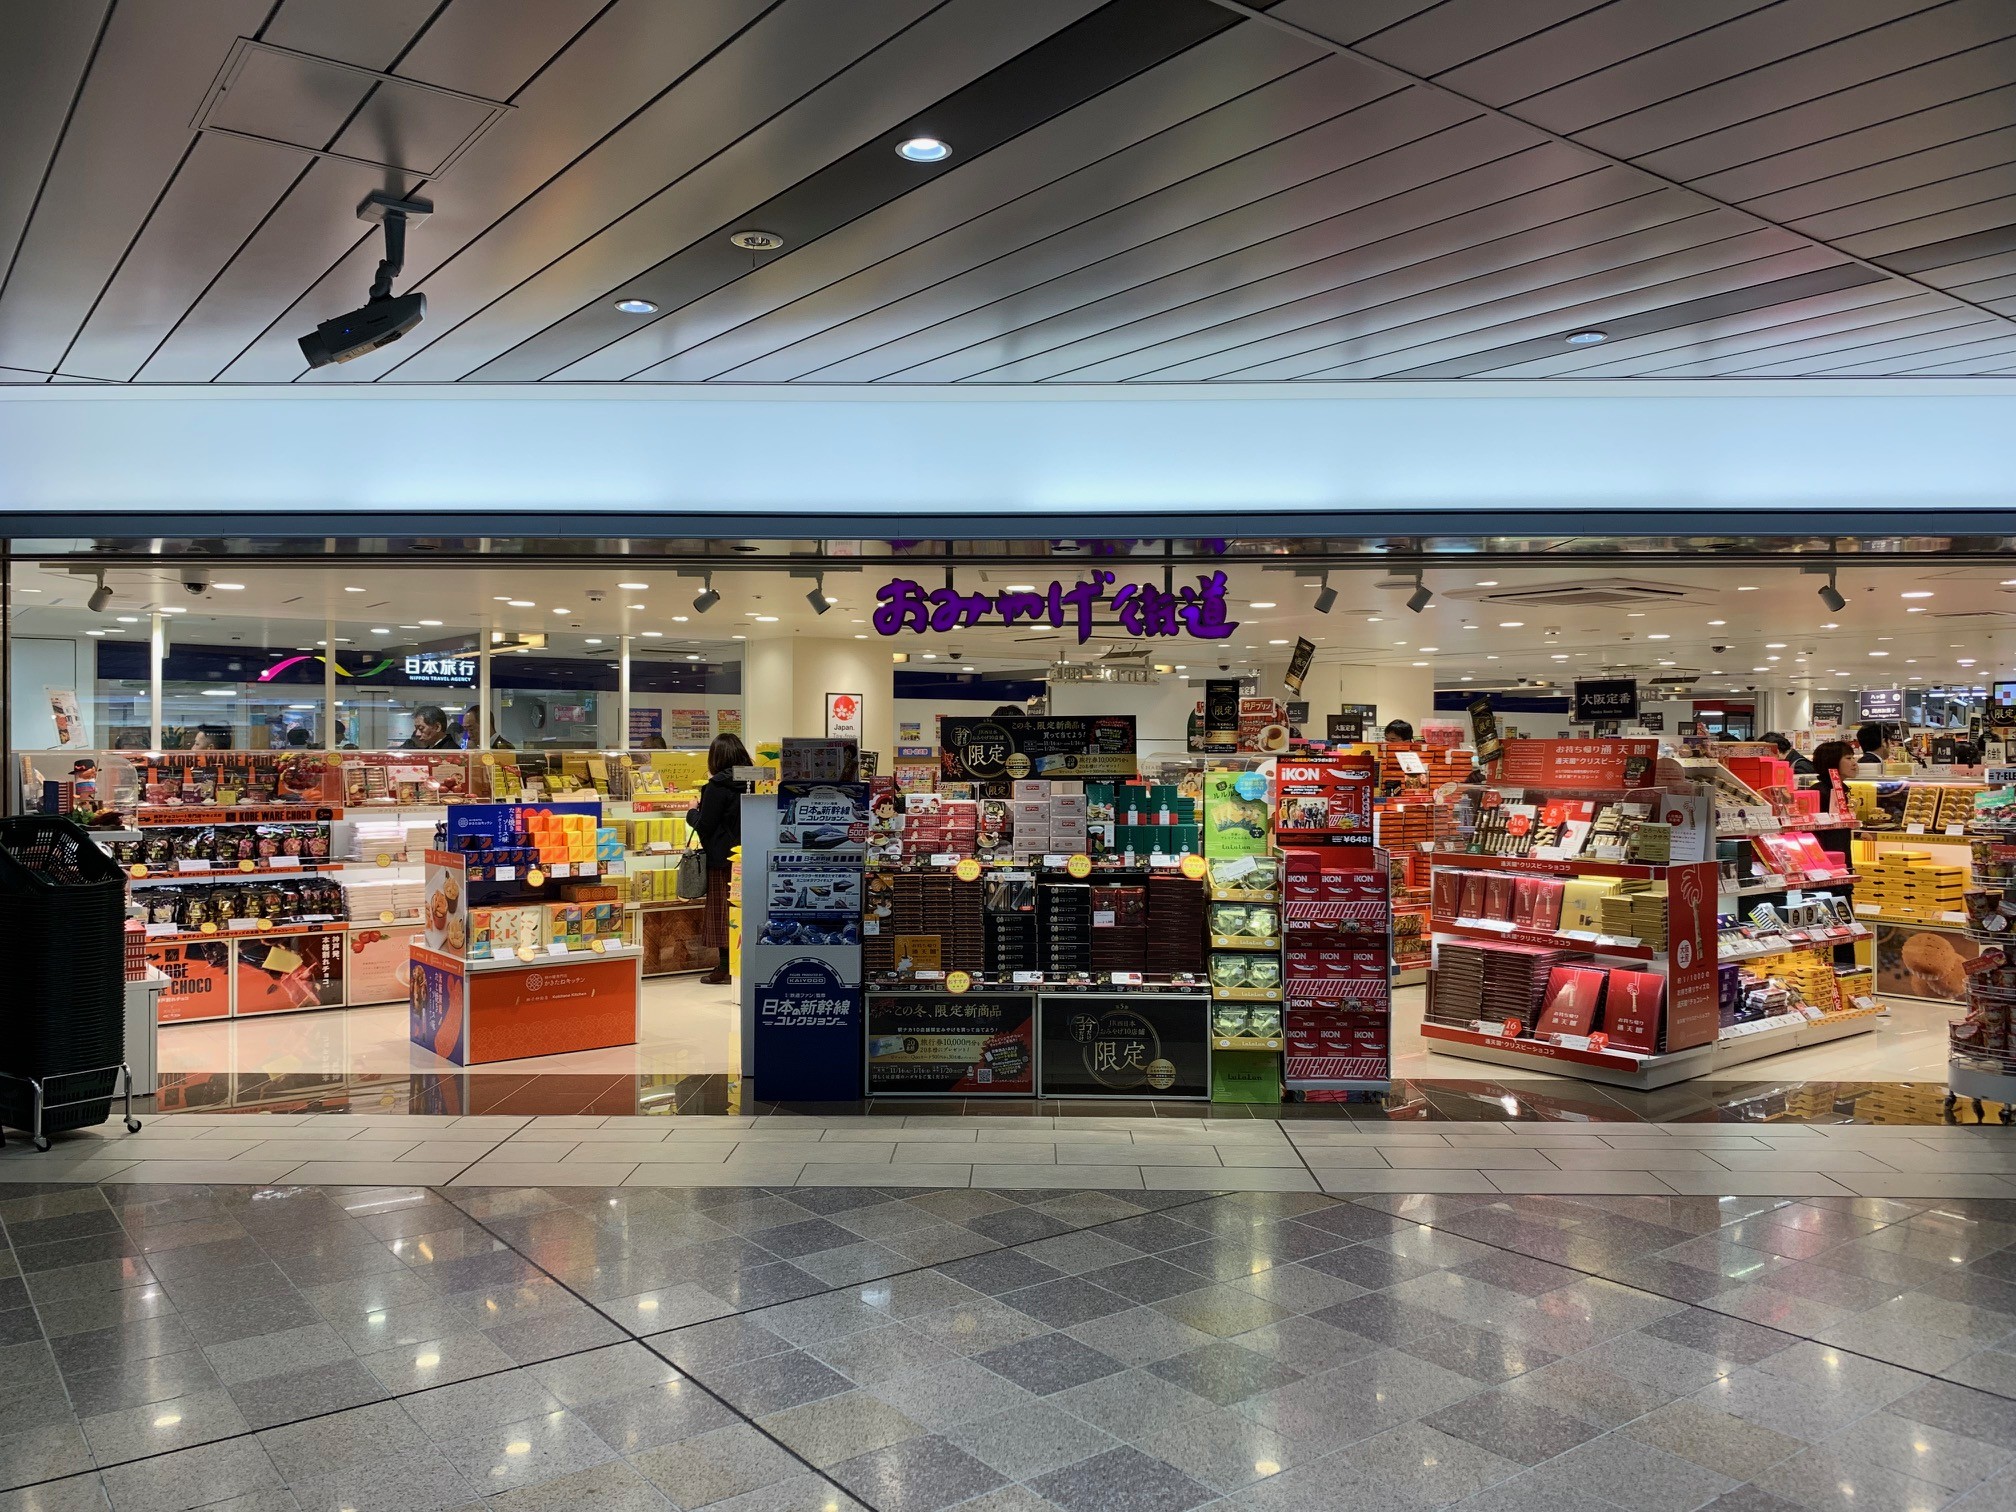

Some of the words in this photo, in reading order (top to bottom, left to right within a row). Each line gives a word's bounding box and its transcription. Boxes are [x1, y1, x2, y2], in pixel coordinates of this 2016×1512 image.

[873, 569, 1239, 645] おみやげ街道
[405, 659, 475, 675] 日本旅行
[1581, 693, 1631, 705] 大阪定番
[1214, 705, 1234, 716] 限定
[1242, 702, 1272, 712] 神戸プリン
[1995, 709, 2014, 719] 限定
[834, 724, 855, 732] Japan.
[967, 745, 1006, 766] 限定
[169, 755, 201, 767] KOBE
[205, 755, 242, 767] WARE
[244, 755, 277, 767] CHOC
[1281, 768, 1320, 781] iKON
[988, 783, 1009, 795] 限定
[799, 806, 850, 815] 日本の新幹線
[1550, 809, 1557, 817] 8
[239, 812, 259, 822] KOBE
[262, 812, 284, 821] WARE
[286, 811, 311, 820] CHOCO
[1514, 818, 1524, 826] 16
[1288, 875, 1308, 883] iKON
[1322, 875, 1342, 883] iKON
[1354, 875, 1374, 883] iKON
[1290, 921, 1311, 929] iKON
[1680, 944, 1689, 954] 大阪
[172, 977, 212, 995] CHOCO
[544, 978, 585, 986] かきたねキッチン
[947, 978, 969, 986] おすすめ
[762, 999, 851, 1015] 日本の新幹線
[894, 1004, 1002, 1018] この冬、限定新商品
[773, 1017, 840, 1026] コレクション
[1506, 1020, 1516, 1029] 16
[1100, 1028, 1146, 1036] おみやげ10店舗
[1591, 1035, 1603, 1043] 24
[1094, 1041, 1148, 1072] 限定
